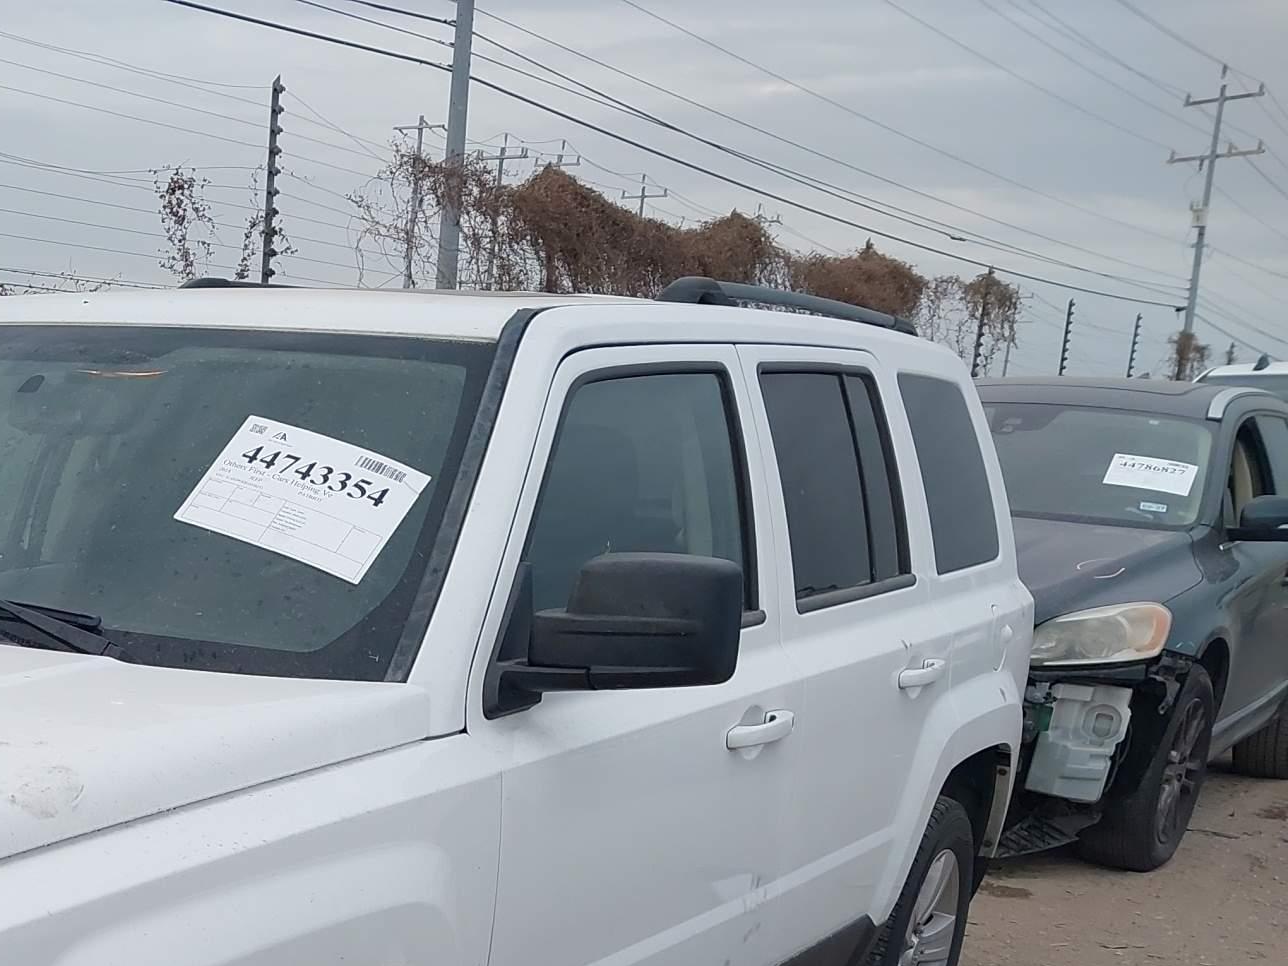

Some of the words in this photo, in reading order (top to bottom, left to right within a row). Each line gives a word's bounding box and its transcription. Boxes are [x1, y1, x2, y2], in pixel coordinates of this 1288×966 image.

[223, 459, 247, 471] Others
[248, 465, 266, 477] First
[272, 473, 289, 484] Cars
[291, 479, 321, 495] Helping
[241, 445, 391, 508] 44743354
[1120, 461, 1186, 475] 44786827
